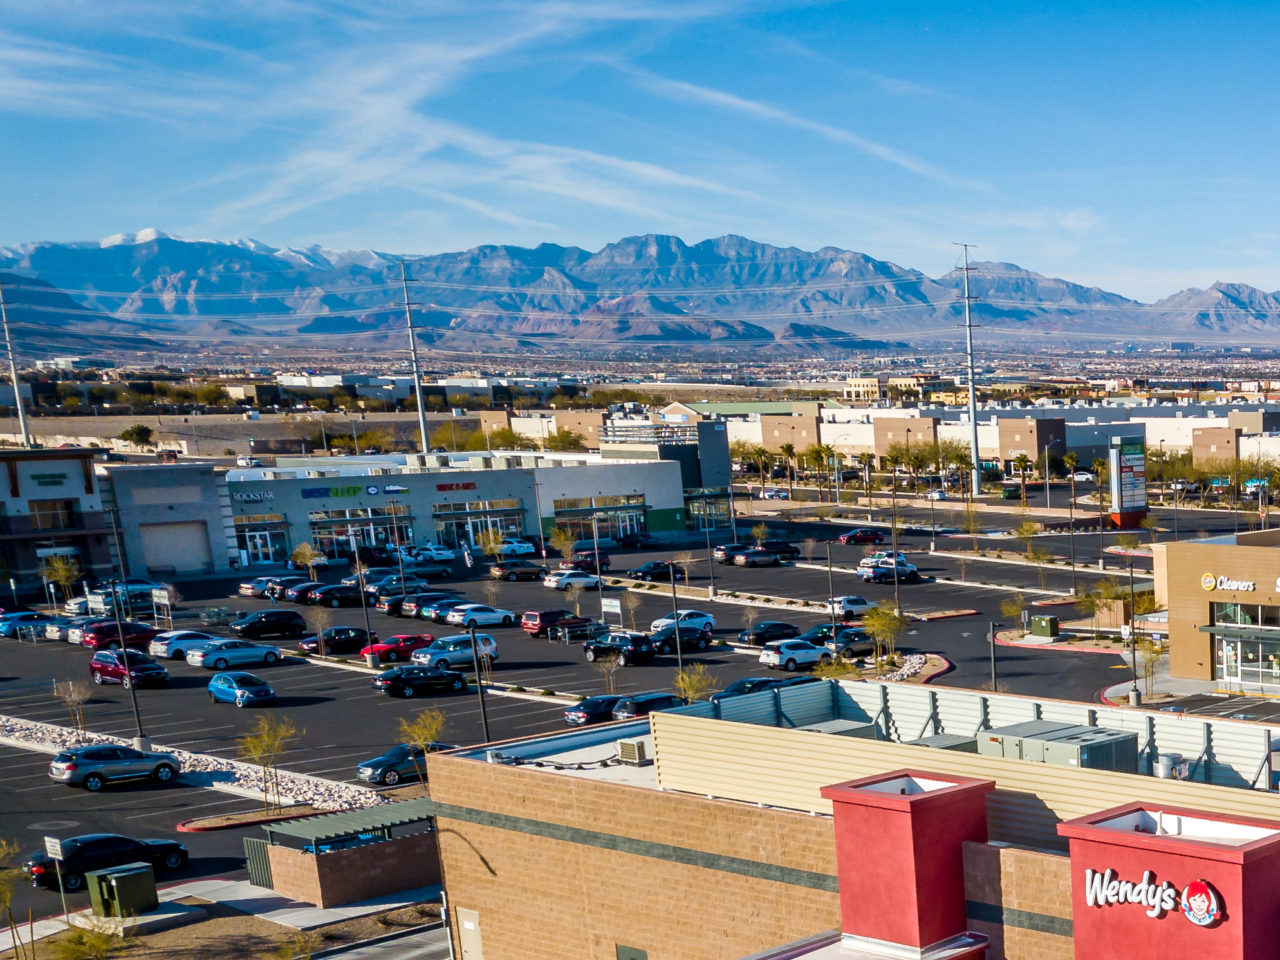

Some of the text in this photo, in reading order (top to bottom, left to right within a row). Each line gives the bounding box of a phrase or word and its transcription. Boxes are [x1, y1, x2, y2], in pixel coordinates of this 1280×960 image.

[233, 491, 274, 500] ROCKSTAR
[1217, 576, 1254, 591] Cleaners
[1085, 868, 1176, 918] Wendy's
